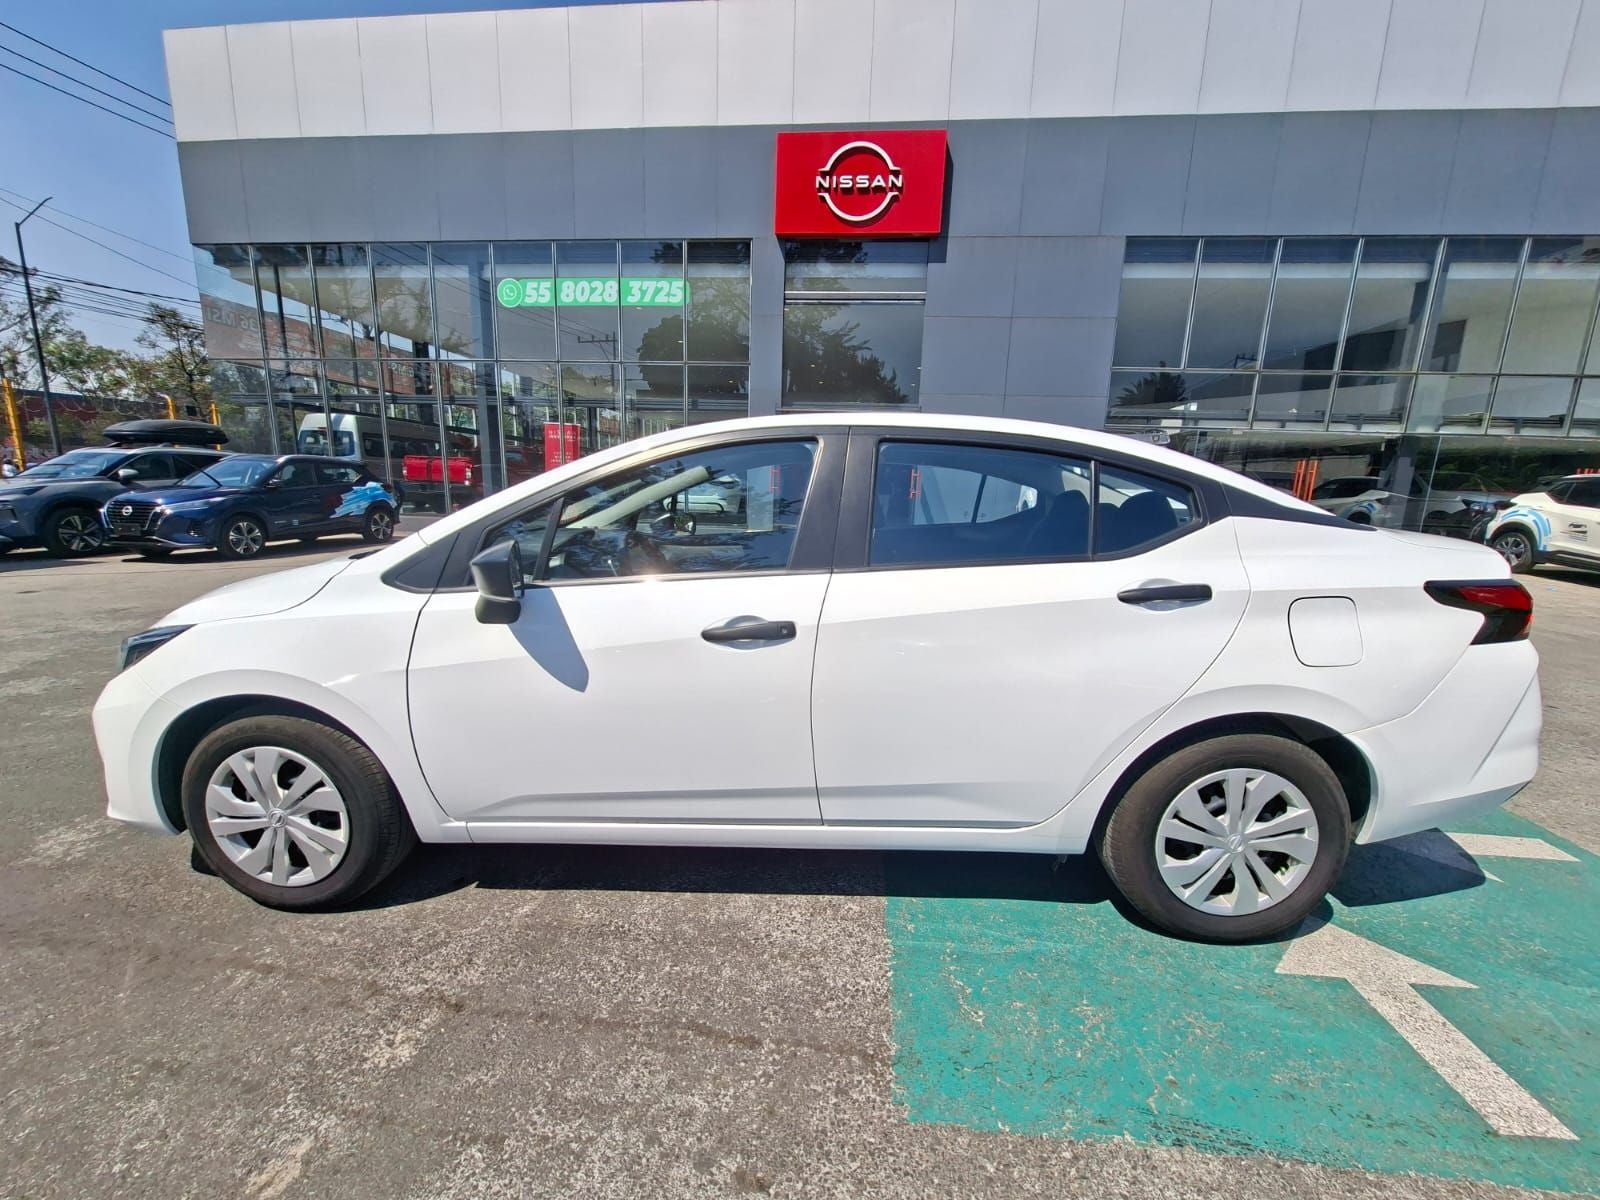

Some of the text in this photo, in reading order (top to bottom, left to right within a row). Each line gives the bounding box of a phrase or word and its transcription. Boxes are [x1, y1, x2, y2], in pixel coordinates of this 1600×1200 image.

[815, 174, 903, 188] NISSAN
[524, 280, 684, 303] 55 8028 3725
